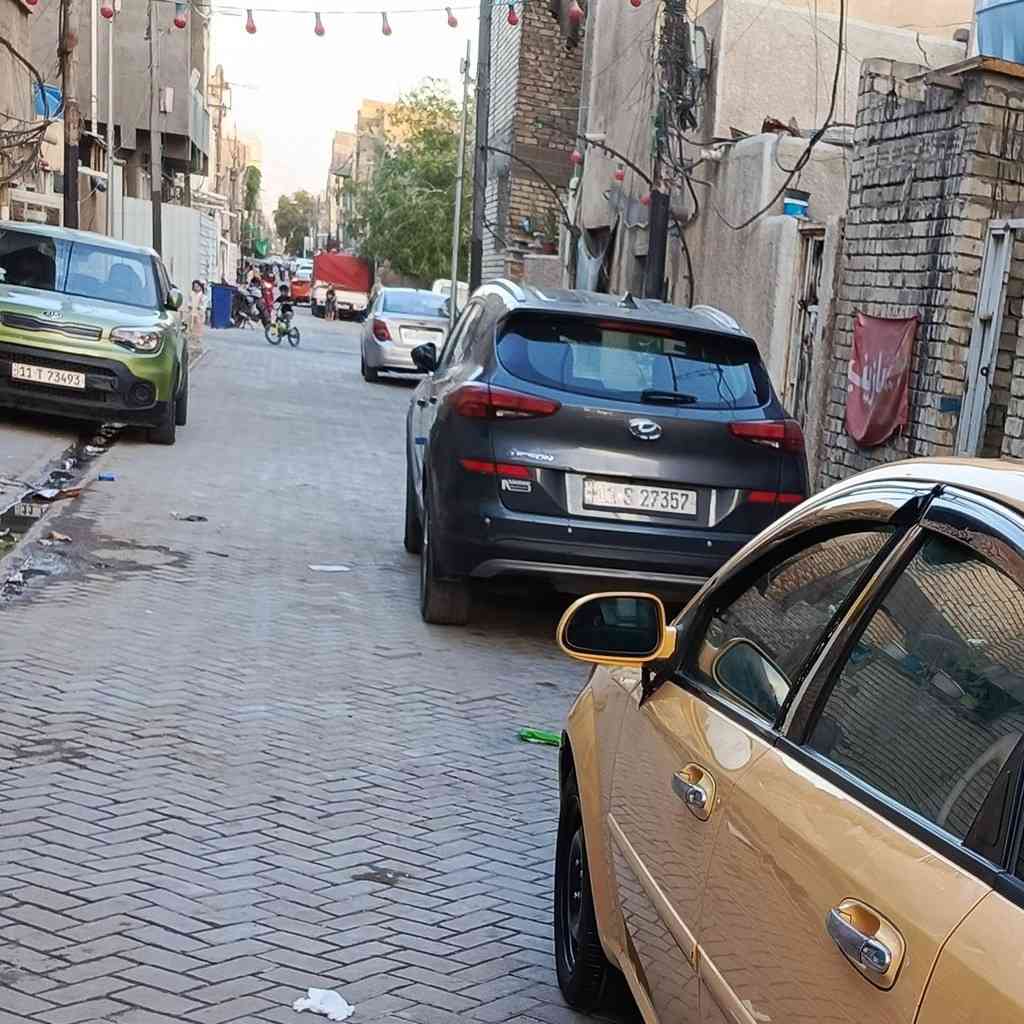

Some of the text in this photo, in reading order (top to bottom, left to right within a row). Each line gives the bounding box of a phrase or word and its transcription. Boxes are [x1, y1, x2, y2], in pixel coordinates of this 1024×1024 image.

[47, 370, 81, 386] 73493
[623, 487, 633, 506] S
[639, 488, 690, 511] 27357
